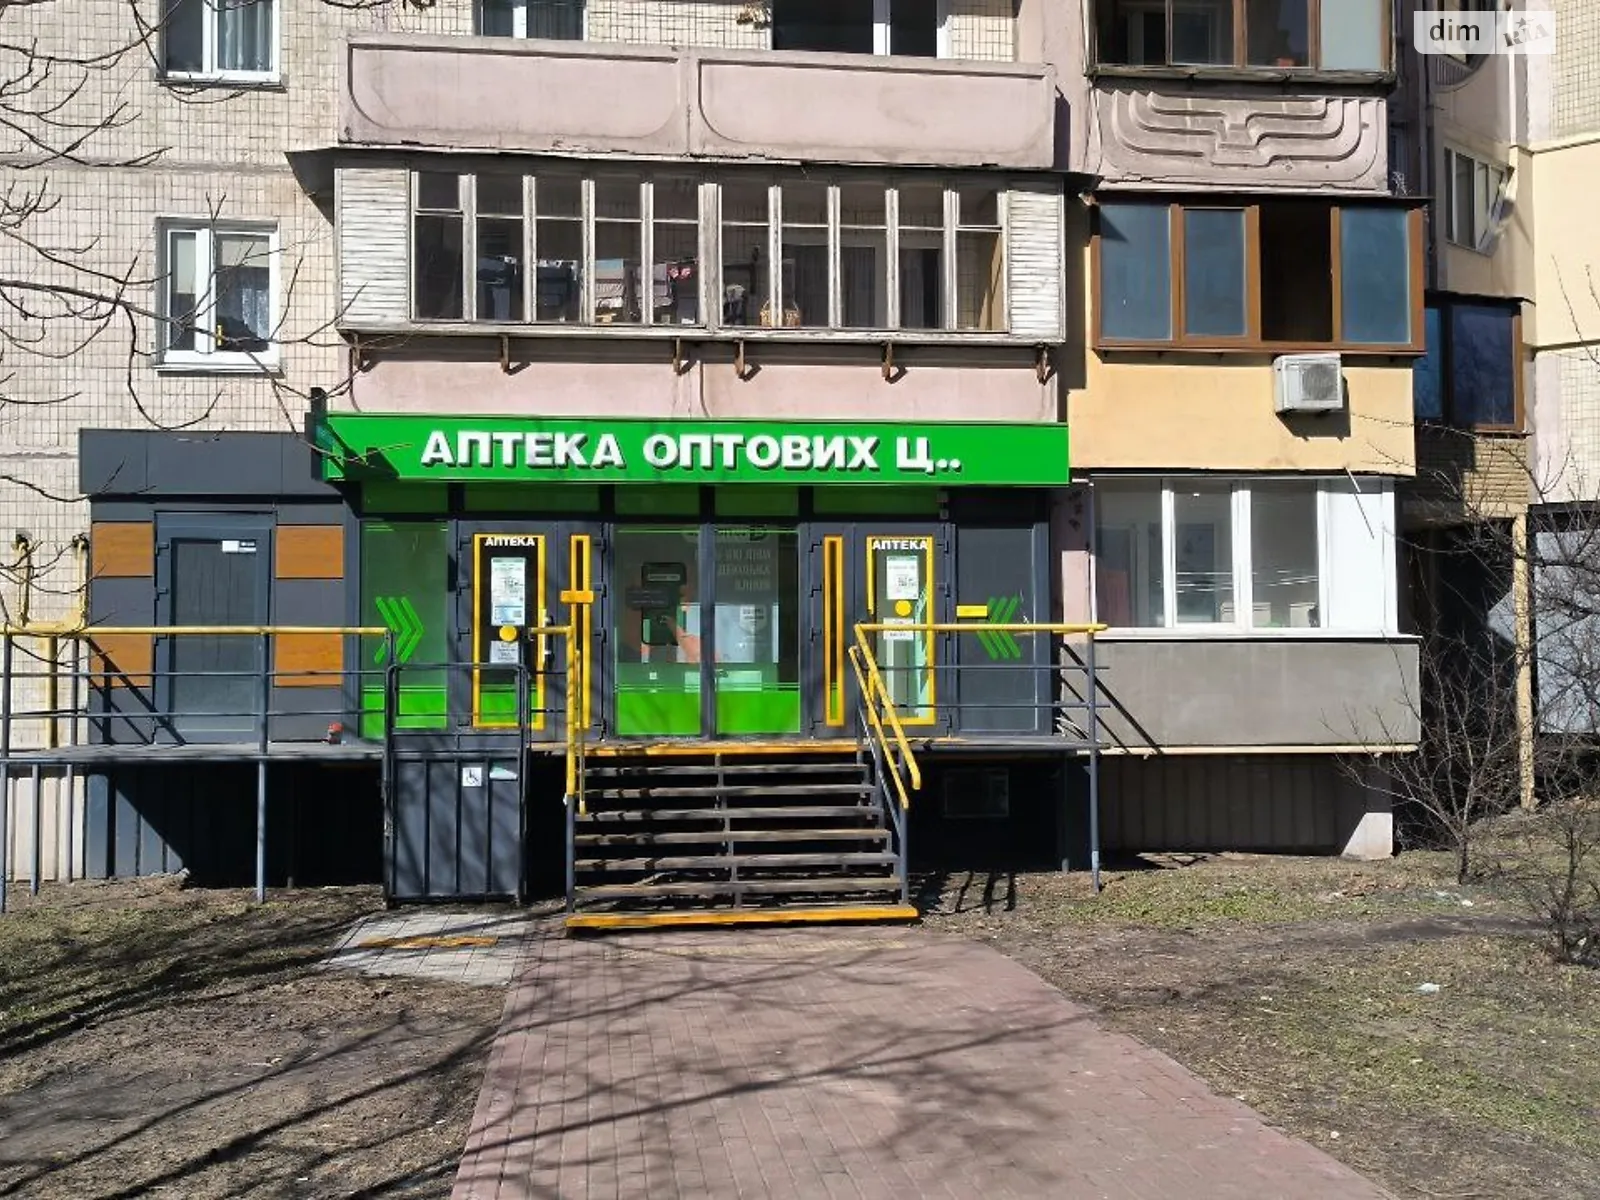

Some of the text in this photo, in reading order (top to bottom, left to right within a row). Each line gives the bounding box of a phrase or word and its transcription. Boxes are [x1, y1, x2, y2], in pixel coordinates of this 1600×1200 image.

[420, 430, 626, 468] АПТЕКА
[642, 433, 880, 471] ОПТОВИХ
[484, 535, 536, 547] АПТЕКА
[872, 539, 928, 551] АПТЕКА
